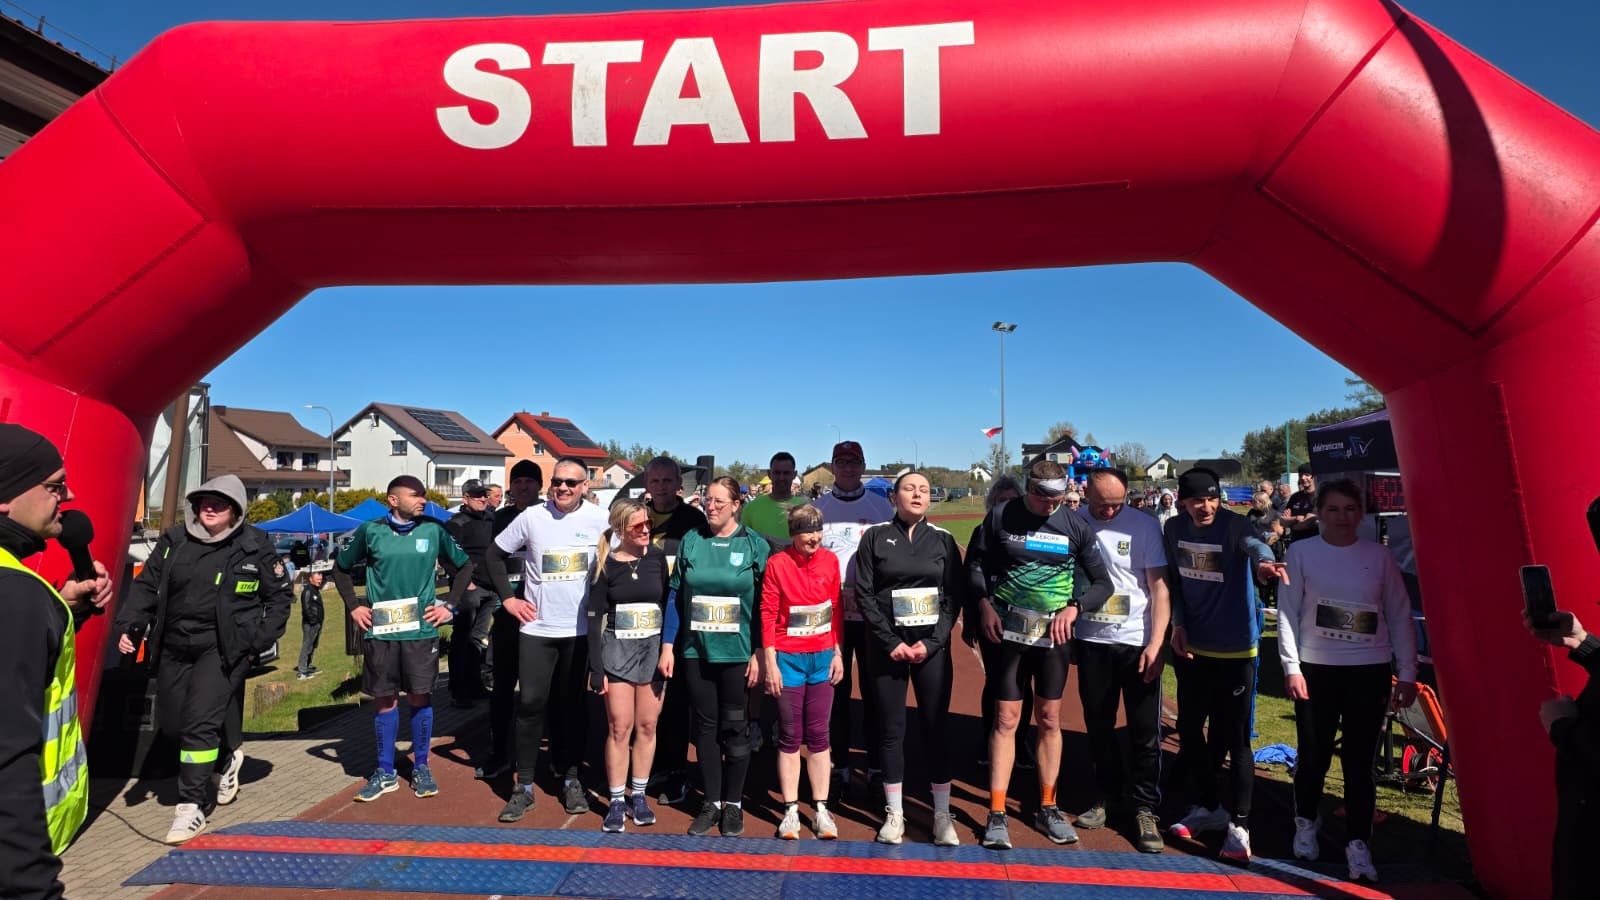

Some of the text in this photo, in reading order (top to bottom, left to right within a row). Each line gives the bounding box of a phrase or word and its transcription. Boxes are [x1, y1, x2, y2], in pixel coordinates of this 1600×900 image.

[436, 21, 975, 149] START
[559, 555, 570, 569] 9
[1191, 552, 1206, 569] 17
[708, 605, 726, 621] 10
[909, 597, 929, 615] 16
[388, 607, 404, 623] 12
[632, 611, 650, 629] 15
[804, 611, 822, 626] 13
[1342, 612, 1353, 629] 2
[1022, 617, 1041, 635] 14
